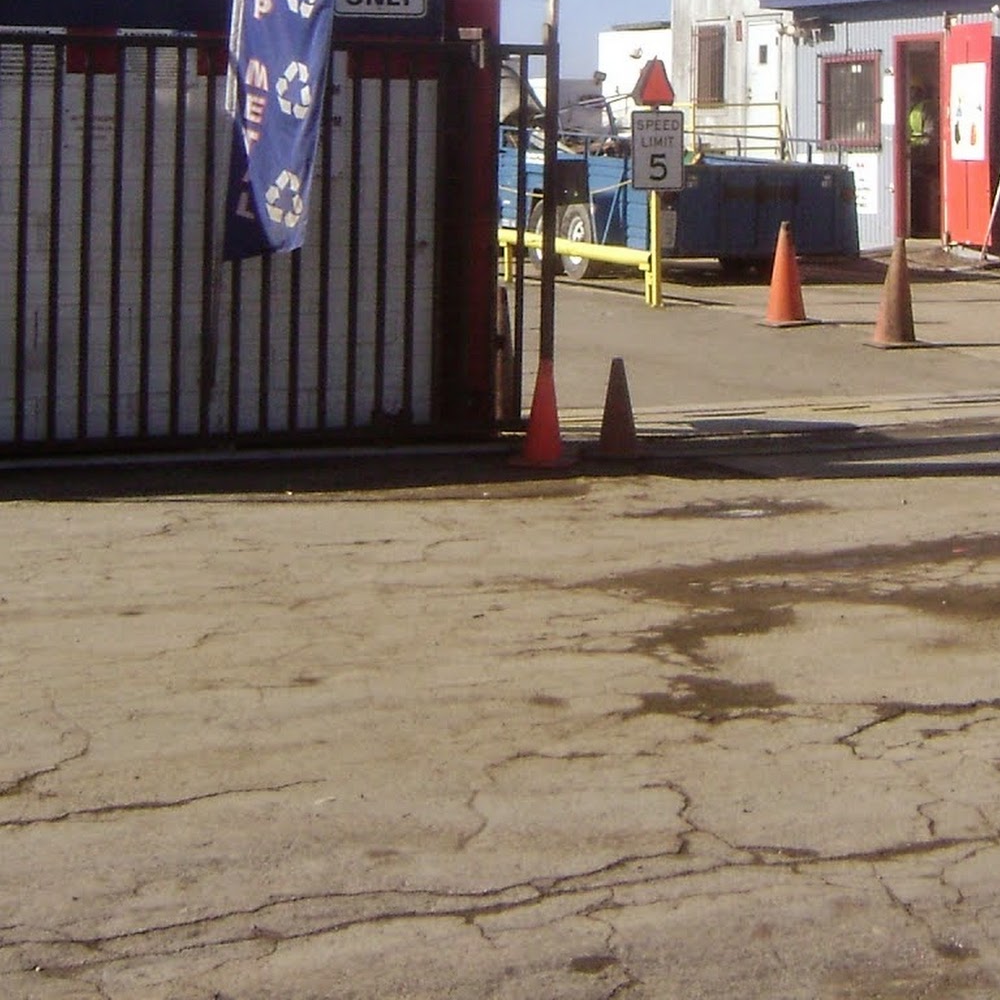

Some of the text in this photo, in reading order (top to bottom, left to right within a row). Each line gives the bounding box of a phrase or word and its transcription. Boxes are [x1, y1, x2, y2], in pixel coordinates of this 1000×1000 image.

[636, 119, 680, 132] SPEED
[236, 59, 269, 219] METL
[641, 137, 675, 148] LIMIT
[649, 153, 668, 181] 5
